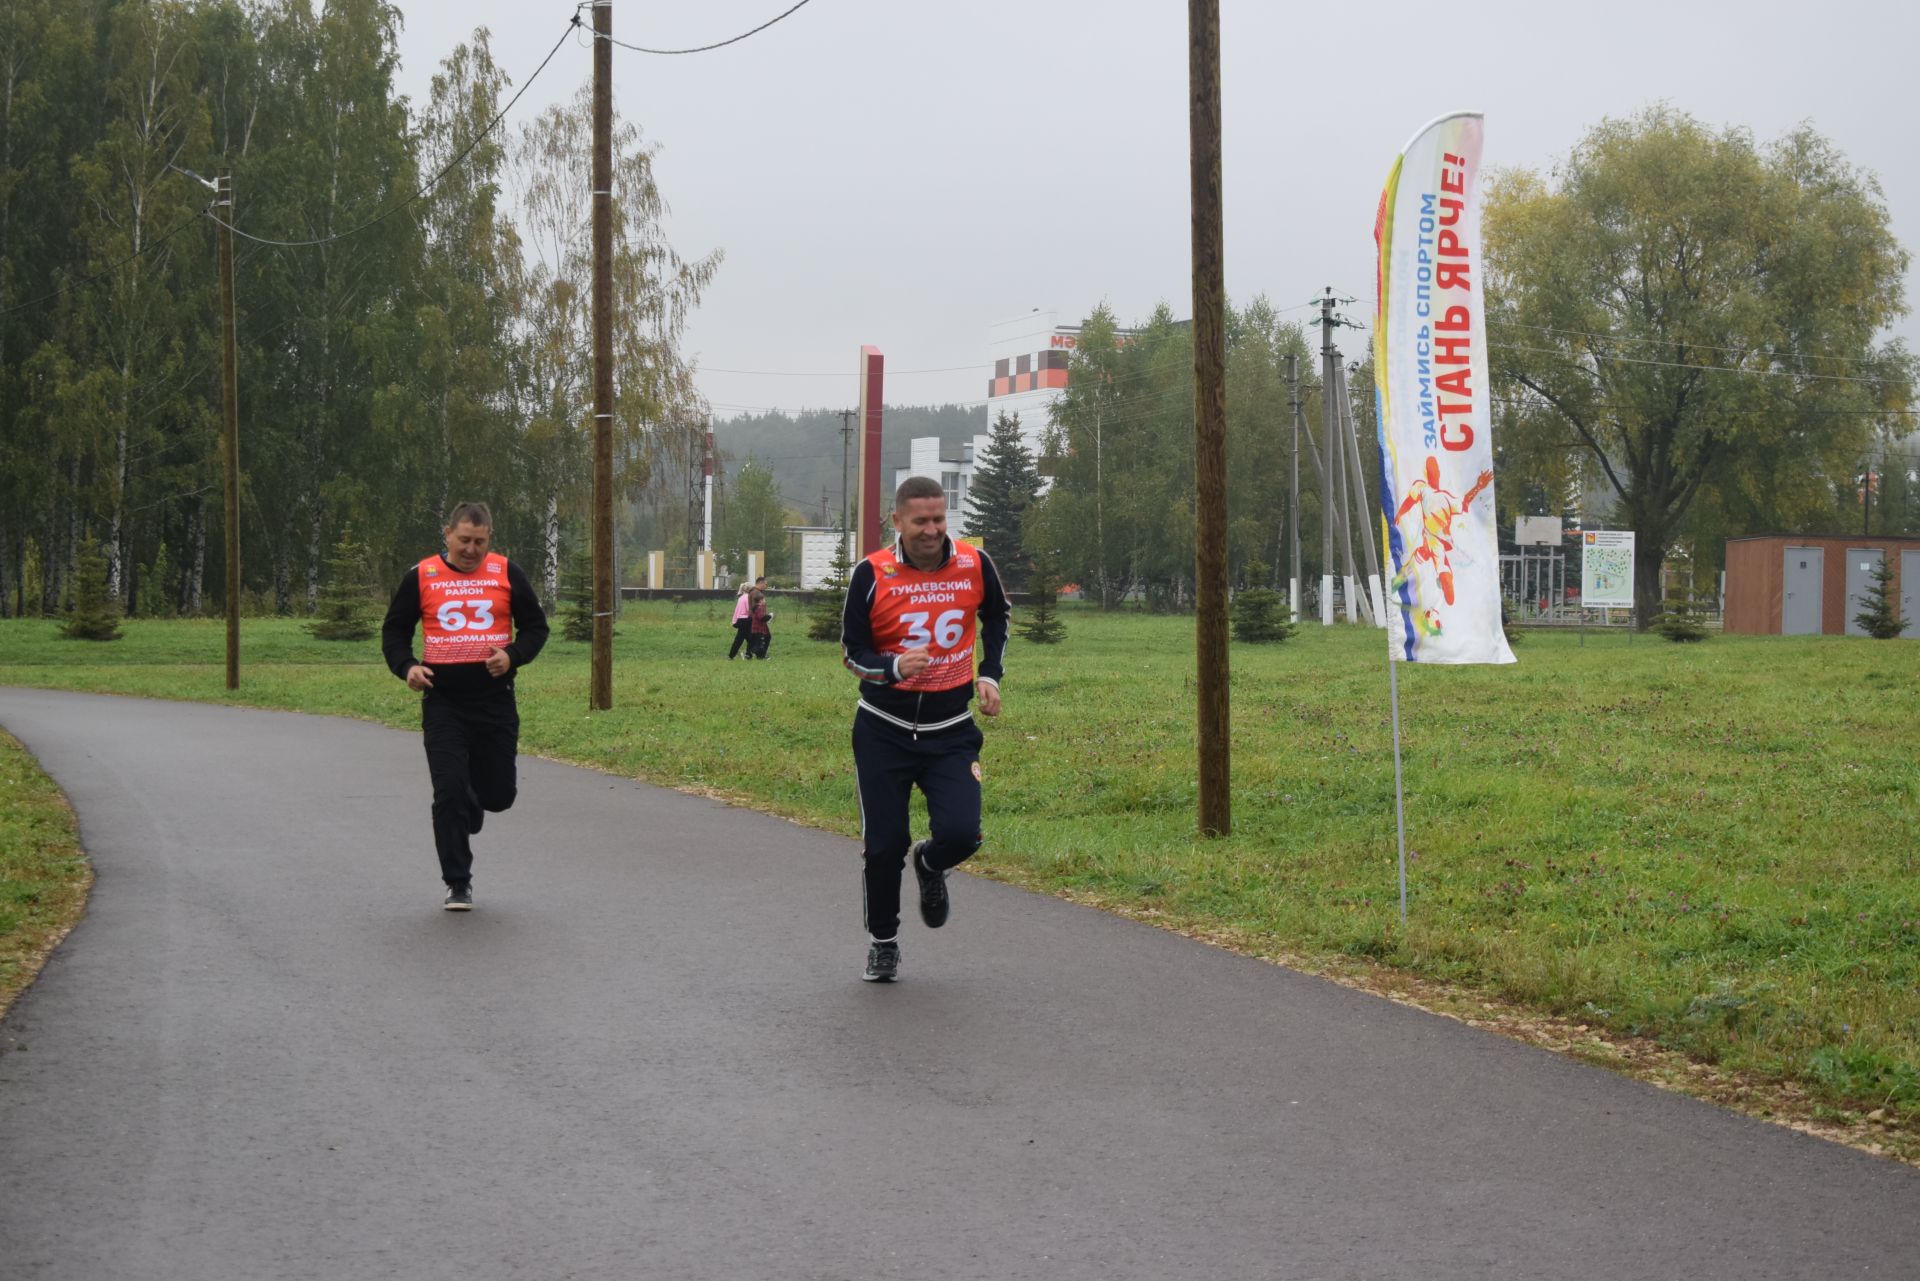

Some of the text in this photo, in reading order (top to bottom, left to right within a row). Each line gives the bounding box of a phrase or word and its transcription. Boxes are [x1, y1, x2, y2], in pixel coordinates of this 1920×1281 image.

[1434, 152, 1474, 452] СТАНЬ ЯРЧЕ!
[1416, 193, 1437, 449] ЗАЙМИСЬ СПОРТОМ
[430, 579, 499, 590] ТУКАЕВСКИЙ
[445, 587, 484, 597] РАЙОН
[890, 578, 972, 596] ТУКАЕВСКИЙ
[910, 593, 955, 605] РАЙОН
[436, 599, 495, 632] 63
[899, 609, 965, 649] 36
